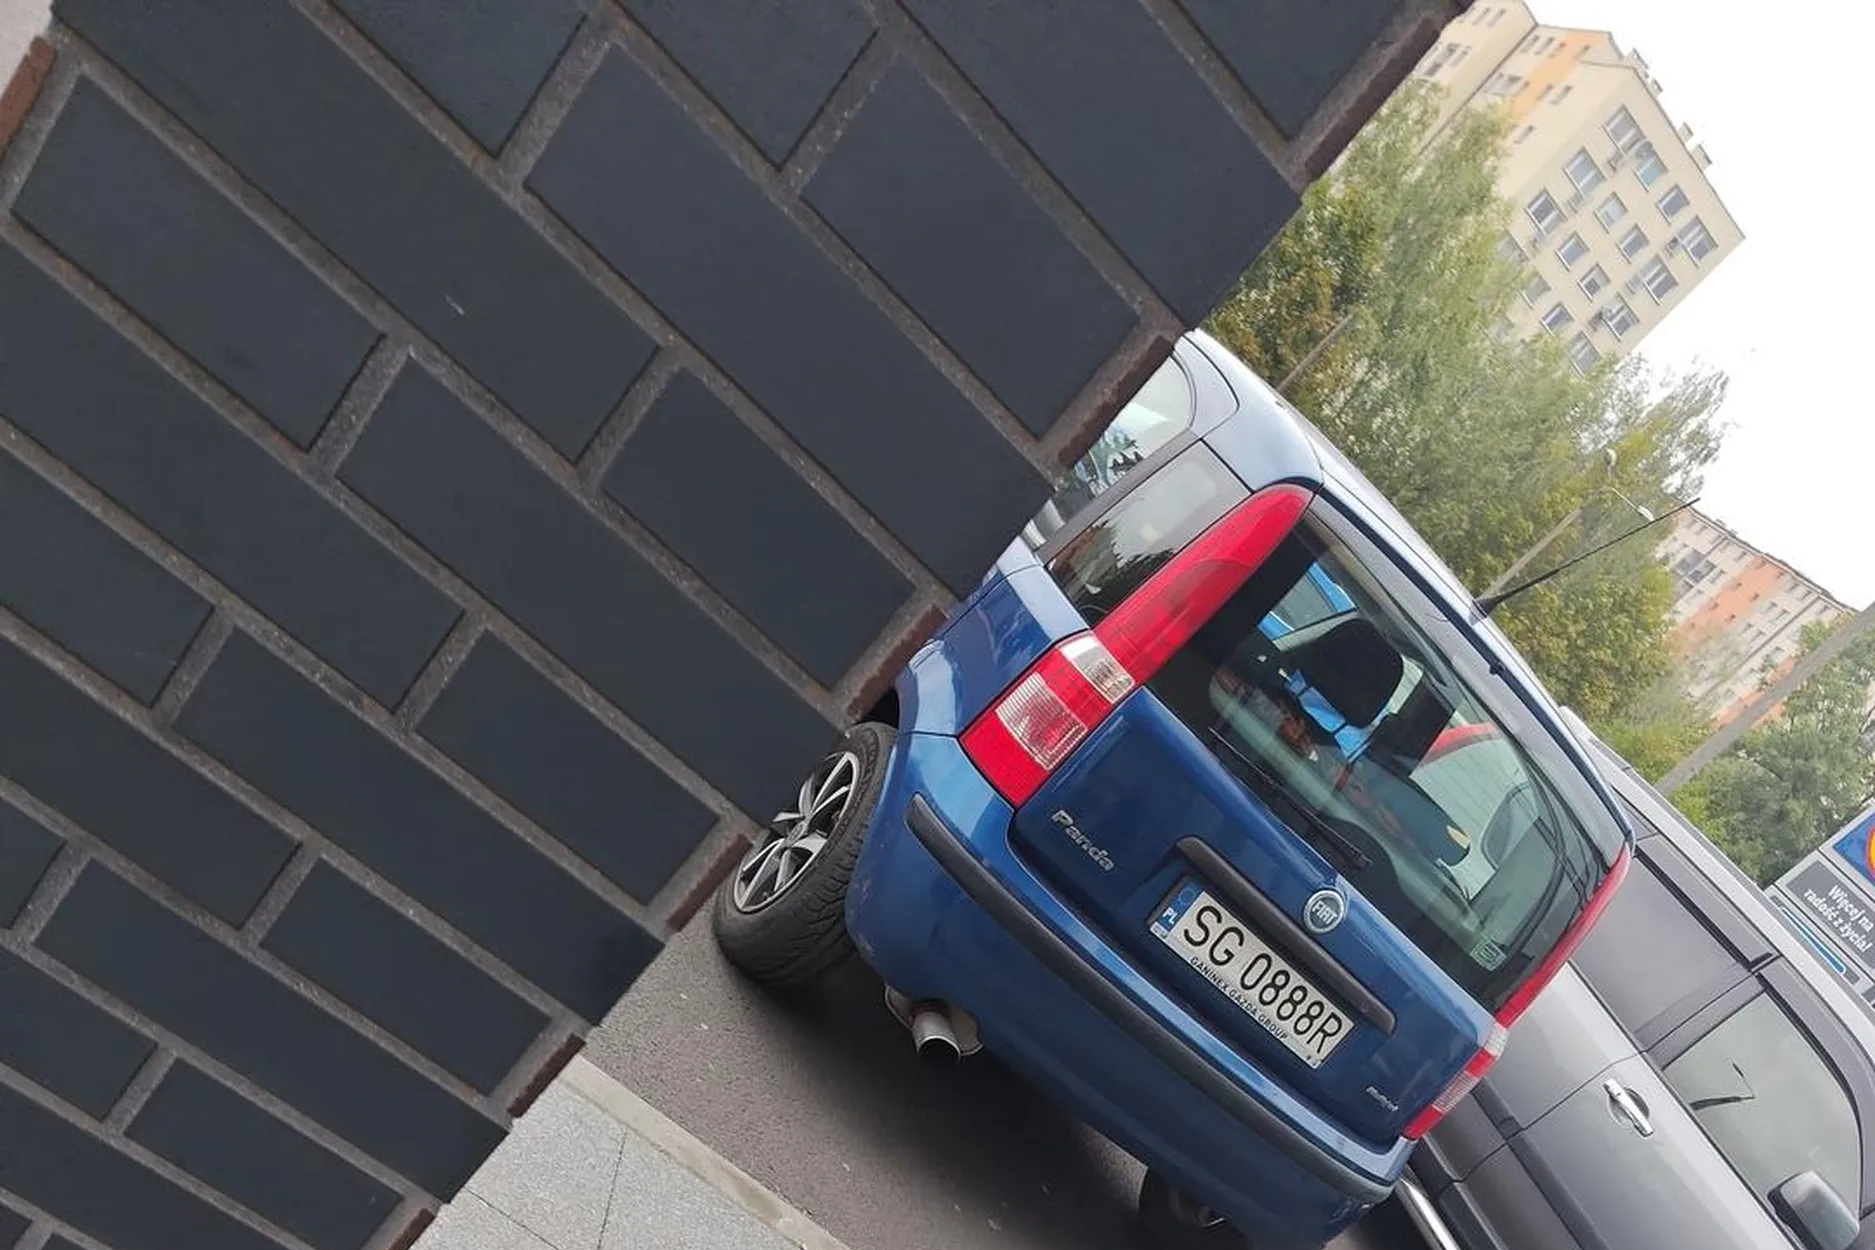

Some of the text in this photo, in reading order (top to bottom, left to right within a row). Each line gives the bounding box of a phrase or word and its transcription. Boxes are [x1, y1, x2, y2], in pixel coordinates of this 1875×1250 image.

[1051, 809, 1114, 871] Panda
[1162, 907, 1179, 925] PL
[1311, 900, 1338, 924] FIAT
[1833, 918, 1844, 928] z
[1858, 916, 1874, 932] na
[1183, 905, 1343, 1054] SG 0888R
[1189, 956, 1229, 992] GANINEX
[1258, 1013, 1289, 1040] GROUP
